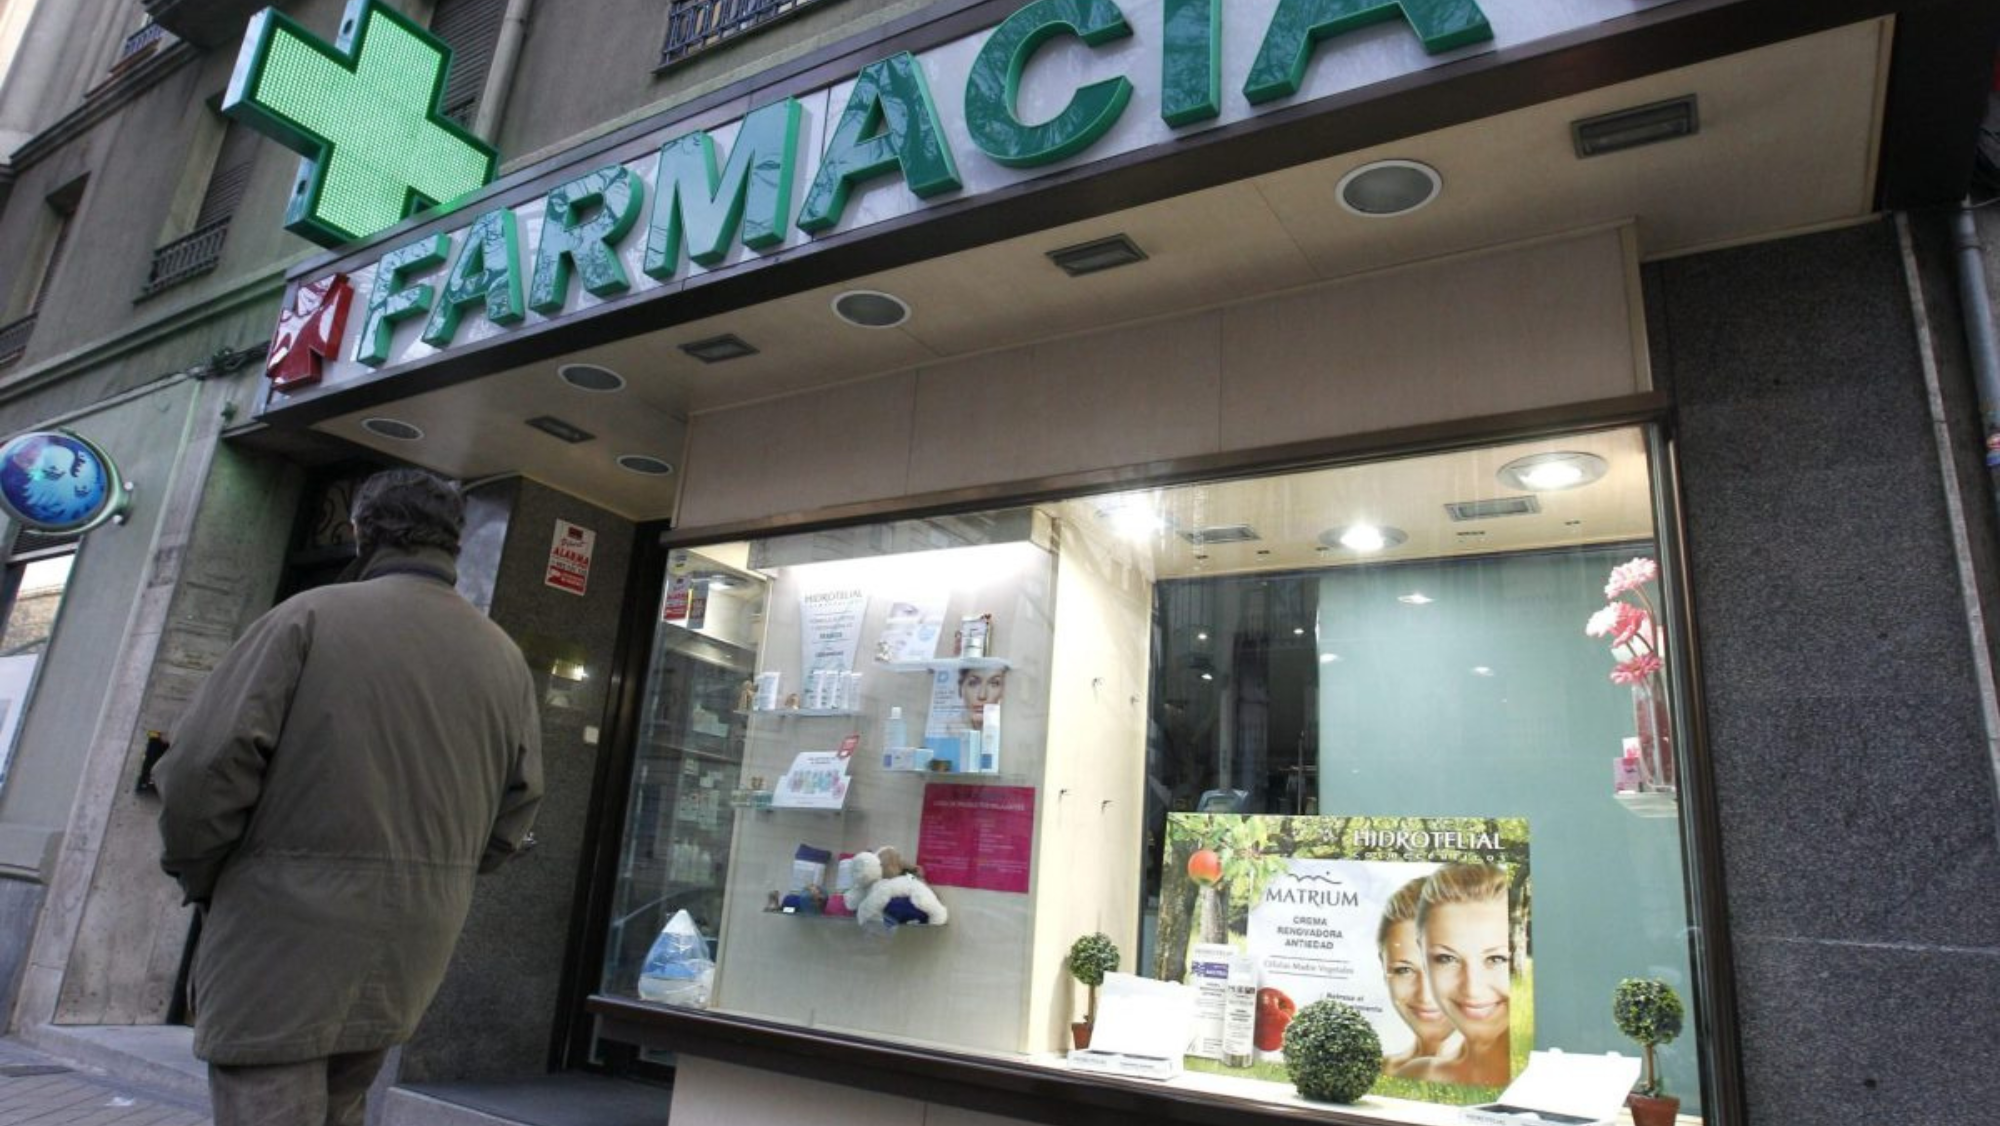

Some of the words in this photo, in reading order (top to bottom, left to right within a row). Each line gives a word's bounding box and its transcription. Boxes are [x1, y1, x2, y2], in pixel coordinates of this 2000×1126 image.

[1353, 829, 1506, 850] HIDROTELIAL
[1265, 888, 1359, 907] MATRIUM
[1292, 915, 1328, 926] CREMA
[1277, 926, 1343, 938] RENOVADORA
[1284, 938, 1334, 950] ANTIEDAD
